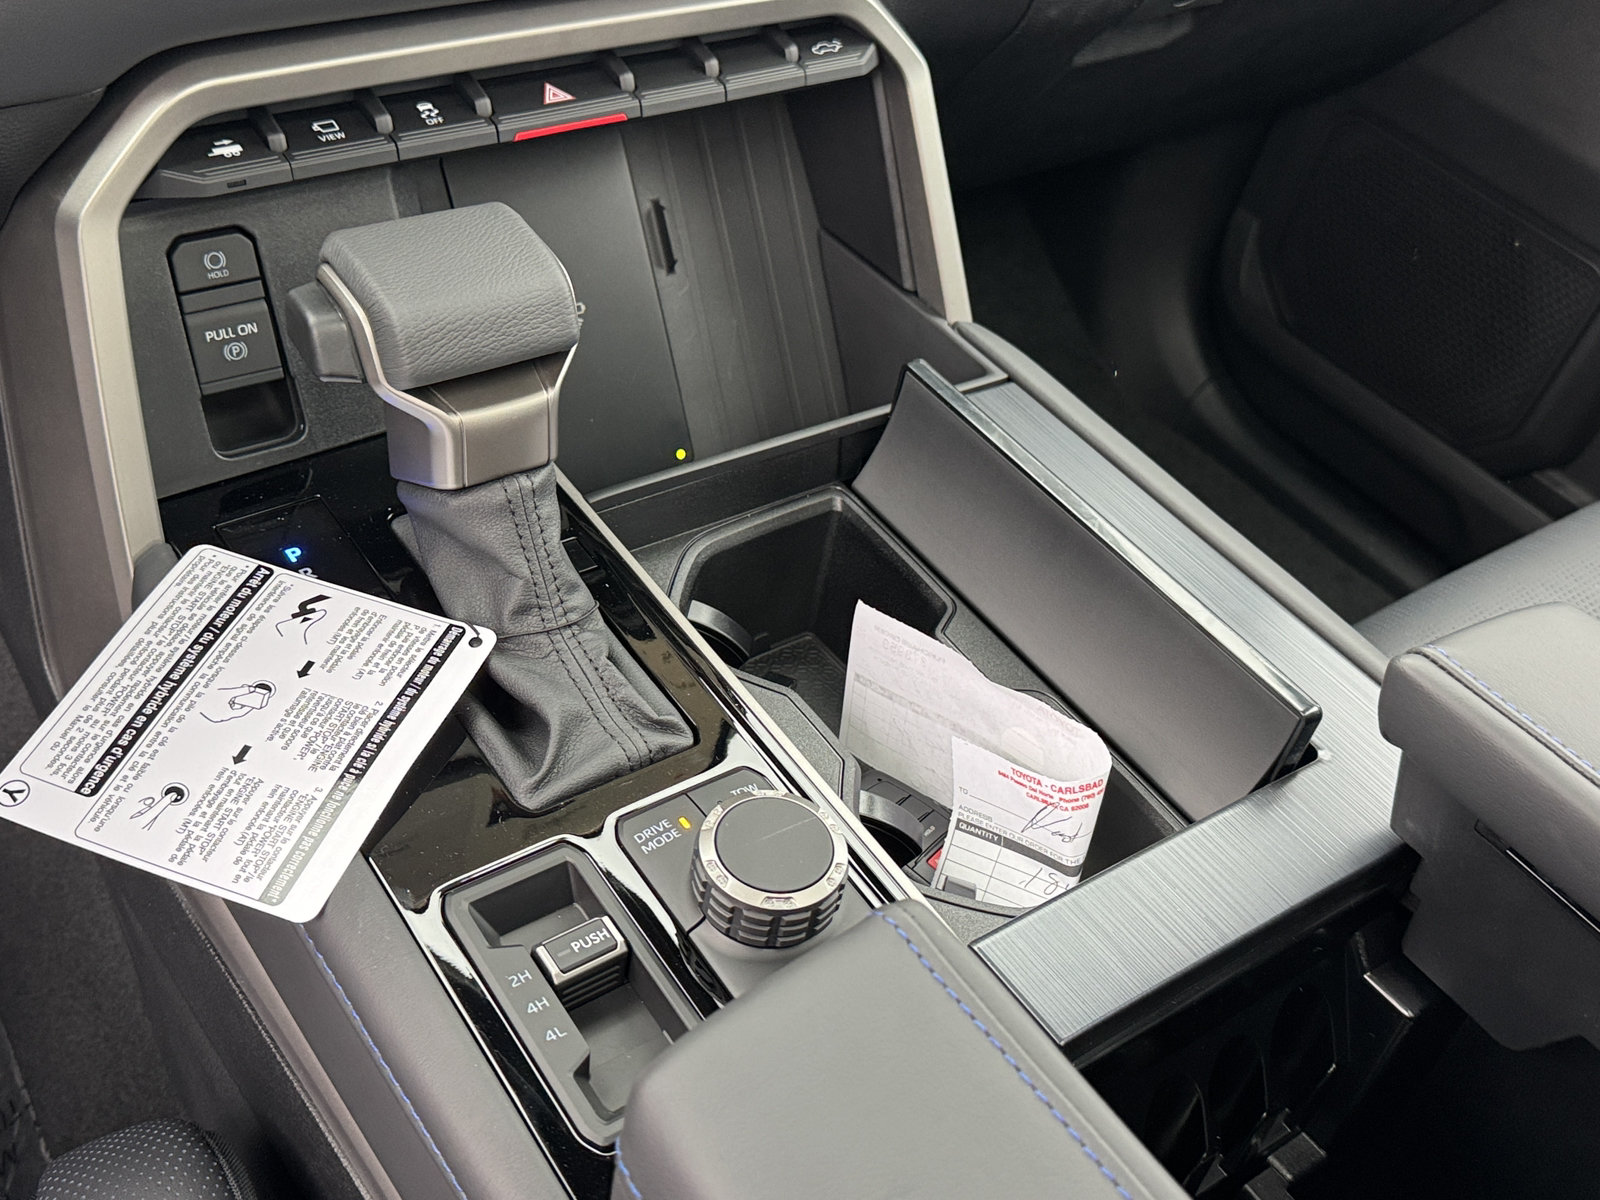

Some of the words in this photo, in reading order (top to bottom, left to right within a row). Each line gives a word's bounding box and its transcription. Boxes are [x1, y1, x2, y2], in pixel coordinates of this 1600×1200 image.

[425, 116, 446, 126] OFF
[318, 130, 346, 143] VIEW
[208, 269, 230, 280] HOLD
[205, 327, 236, 342] PULL
[237, 322, 258, 336] ON
[284, 546, 302, 563] P
[245, 567, 271, 588] Arrêt
[235, 586, 254, 599] du
[211, 598, 244, 628] moteur
[262, 604, 274, 613] les
[204, 625, 221, 633] /
[244, 614, 266, 634] étapes
[197, 631, 217, 645] du
[430, 625, 462, 657] Démarrage
[222, 635, 249, 663] ci-dessus
[166, 642, 207, 681] système
[427, 655, 442, 665] du
[200, 665, 224, 688] lorsque
[412, 664, 436, 685] moteur
[138, 679, 178, 716] hybride
[405, 687, 419, 696] du
[182, 700, 198, 712] pile
[293, 690, 319, 719] retentisse
[314, 695, 336, 717] jusqu'à
[317, 697, 344, 728] contacteur
[333, 700, 353, 721] START
[357, 705, 369, 715] clé
[384, 694, 413, 721] système
[131, 714, 146, 727] en
[329, 709, 357, 742] contacteur
[347, 716, 362, 730] bien
[359, 708, 378, 728] Placer
[117, 728, 136, 745] cas
[276, 726, 290, 739] que
[280, 729, 299, 750] sonore
[298, 725, 312, 738] que
[368, 718, 395, 744] hybride
[158, 736, 171, 747] clé
[332, 736, 347, 749] plat
[333, 728, 364, 764] directement
[365, 742, 379, 750] si
[147, 749, 161, 760] est
[318, 750, 338, 770] contre
[353, 757, 369, 769] clé
[360, 749, 374, 758] la
[76, 745, 126, 796] d'urgence
[132, 762, 151, 781] faible
[214, 766, 229, 781] frein
[233, 772, 247, 785] tout
[238, 777, 264, 805] Appuyer
[267, 783, 282, 798] frein
[335, 772, 354, 790] puce
[959, 786, 968, 796] TO
[1010, 768, 1042, 787] TOYOTA
[1050, 778, 1104, 794] CARLSBAD
[2, 788, 26, 803] Y
[262, 786, 291, 822] maintenant
[332, 790, 343, 799] ne
[200, 797, 229, 832] maintenant
[231, 806, 242, 817] sur
[272, 789, 300, 823] contacteur
[293, 794, 318, 822] Appuyer
[958, 805, 992, 822] ADDRESS
[211, 807, 233, 830] START
[308, 800, 340, 837] fonctionne
[266, 824, 287, 848] START
[286, 824, 297, 835] sur
[633, 818, 673, 845] DRIVE
[958, 811, 984, 826] PLEASE
[985, 821, 1008, 836] ENTER
[1009, 830, 1024, 842] OUR
[1025, 840, 1048, 855] ORDER
[1050, 850, 1064, 862] FOR
[959, 821, 999, 842] QUANTITY
[172, 829, 195, 852] pédale
[200, 827, 230, 862] contacteur
[237, 831, 260, 855] pédale
[296, 835, 313, 850] pas
[640, 828, 682, 856] MODE
[174, 843, 197, 866] pédale
[255, 846, 284, 881] contacteur
[238, 859, 253, 873] tout
[570, 926, 612, 954] PUSH
[508, 970, 532, 988] 2H
[526, 996, 550, 1016] 4H
[544, 1026, 568, 1044] 4L
